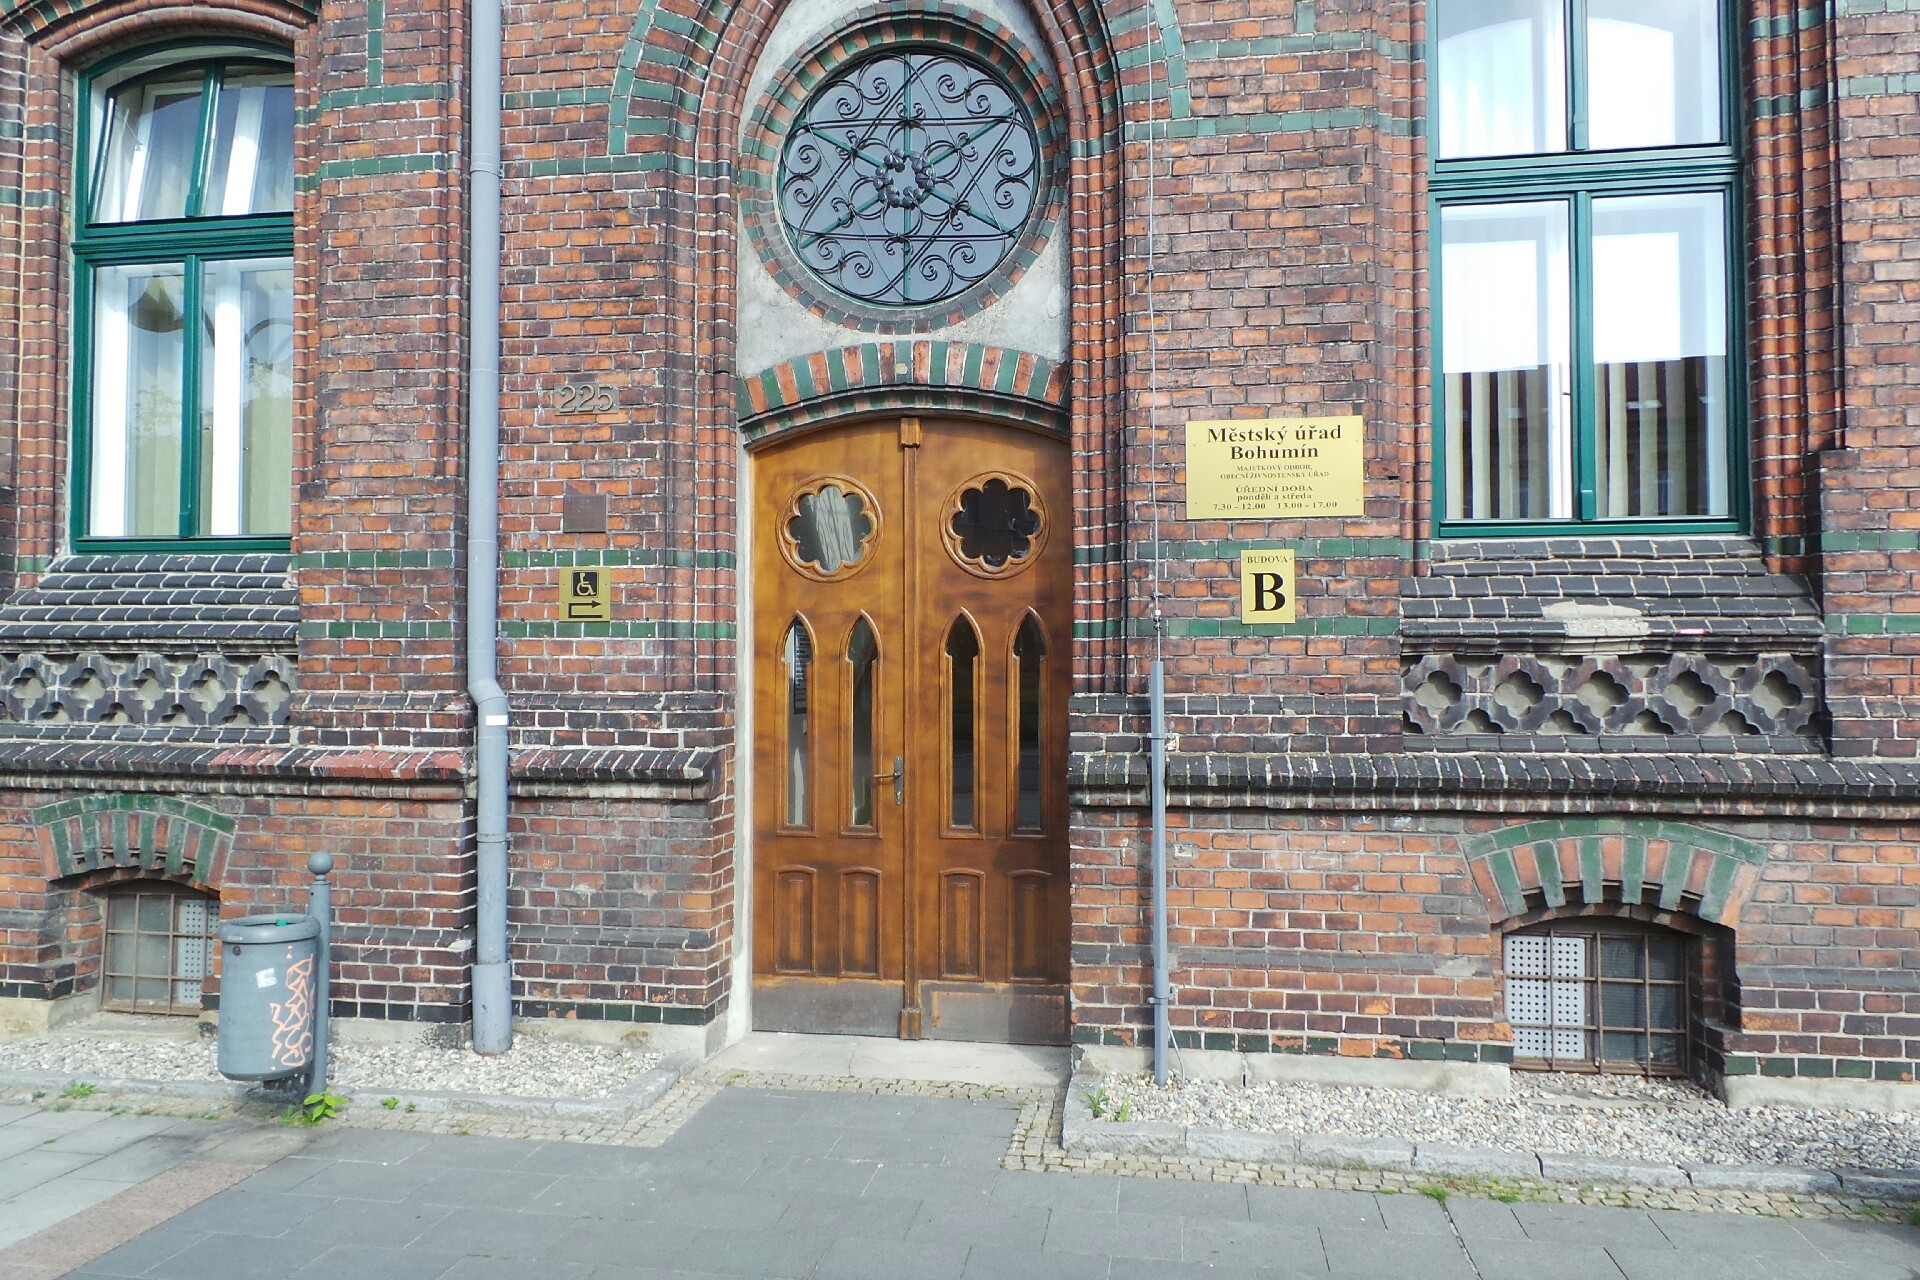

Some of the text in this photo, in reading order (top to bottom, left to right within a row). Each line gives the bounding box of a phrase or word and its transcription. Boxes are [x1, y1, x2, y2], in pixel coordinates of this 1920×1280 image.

[559, 384, 613, 413] 225
[1207, 424, 1342, 445] Městský úřad
[1230, 444, 1319, 460] Bohumín
[1236, 484, 1278, 493] ÚŘEDNÍ
[1237, 493, 1272, 502] pondělí
[1282, 492, 1312, 500] středa
[1212, 503, 1232, 511] 7.30
[1313, 501, 1338, 509] 17.00
[1247, 555, 1288, 564] BUDOVA
[1249, 572, 1286, 612] B
